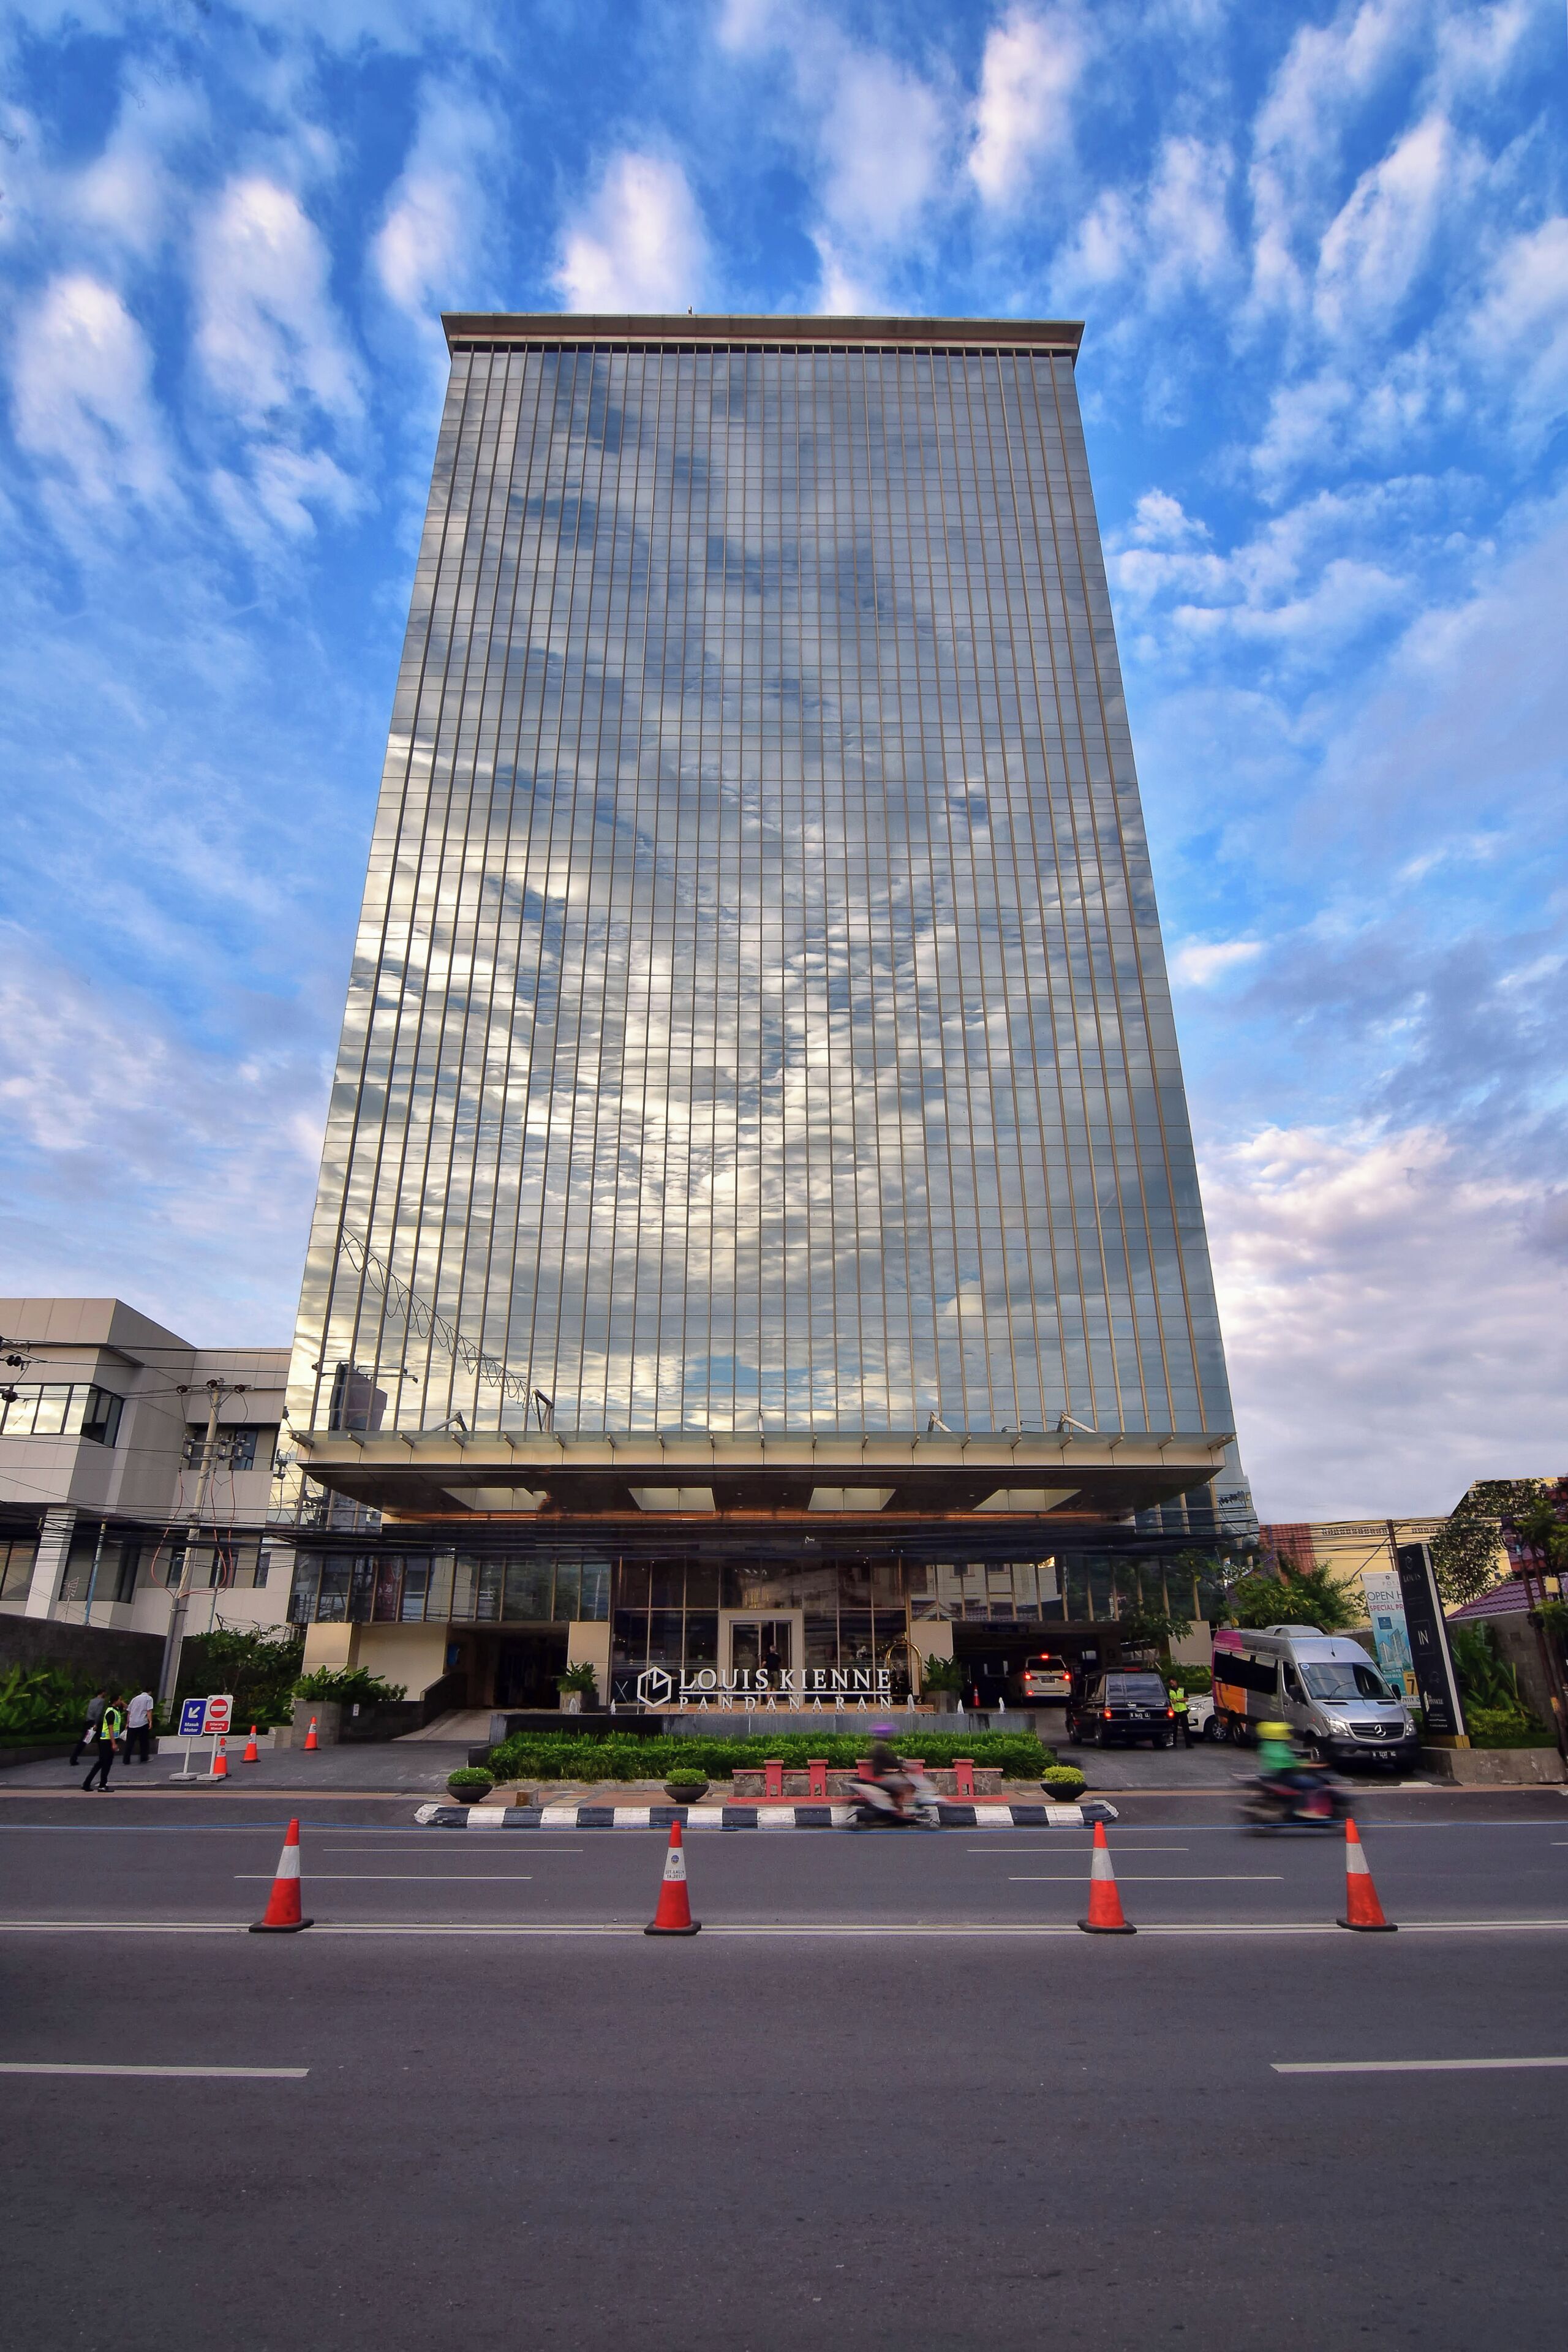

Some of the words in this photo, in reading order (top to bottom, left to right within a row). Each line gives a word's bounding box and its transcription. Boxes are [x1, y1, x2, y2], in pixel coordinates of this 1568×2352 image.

[1366, 1591, 1395, 1600] OPEN
[1417, 1630, 1430, 1645] IN
[679, 1668, 769, 1689] LOUIS
[780, 1668, 891, 1689] KIENNE
[679, 1696, 892, 1709] PANDANARAN
